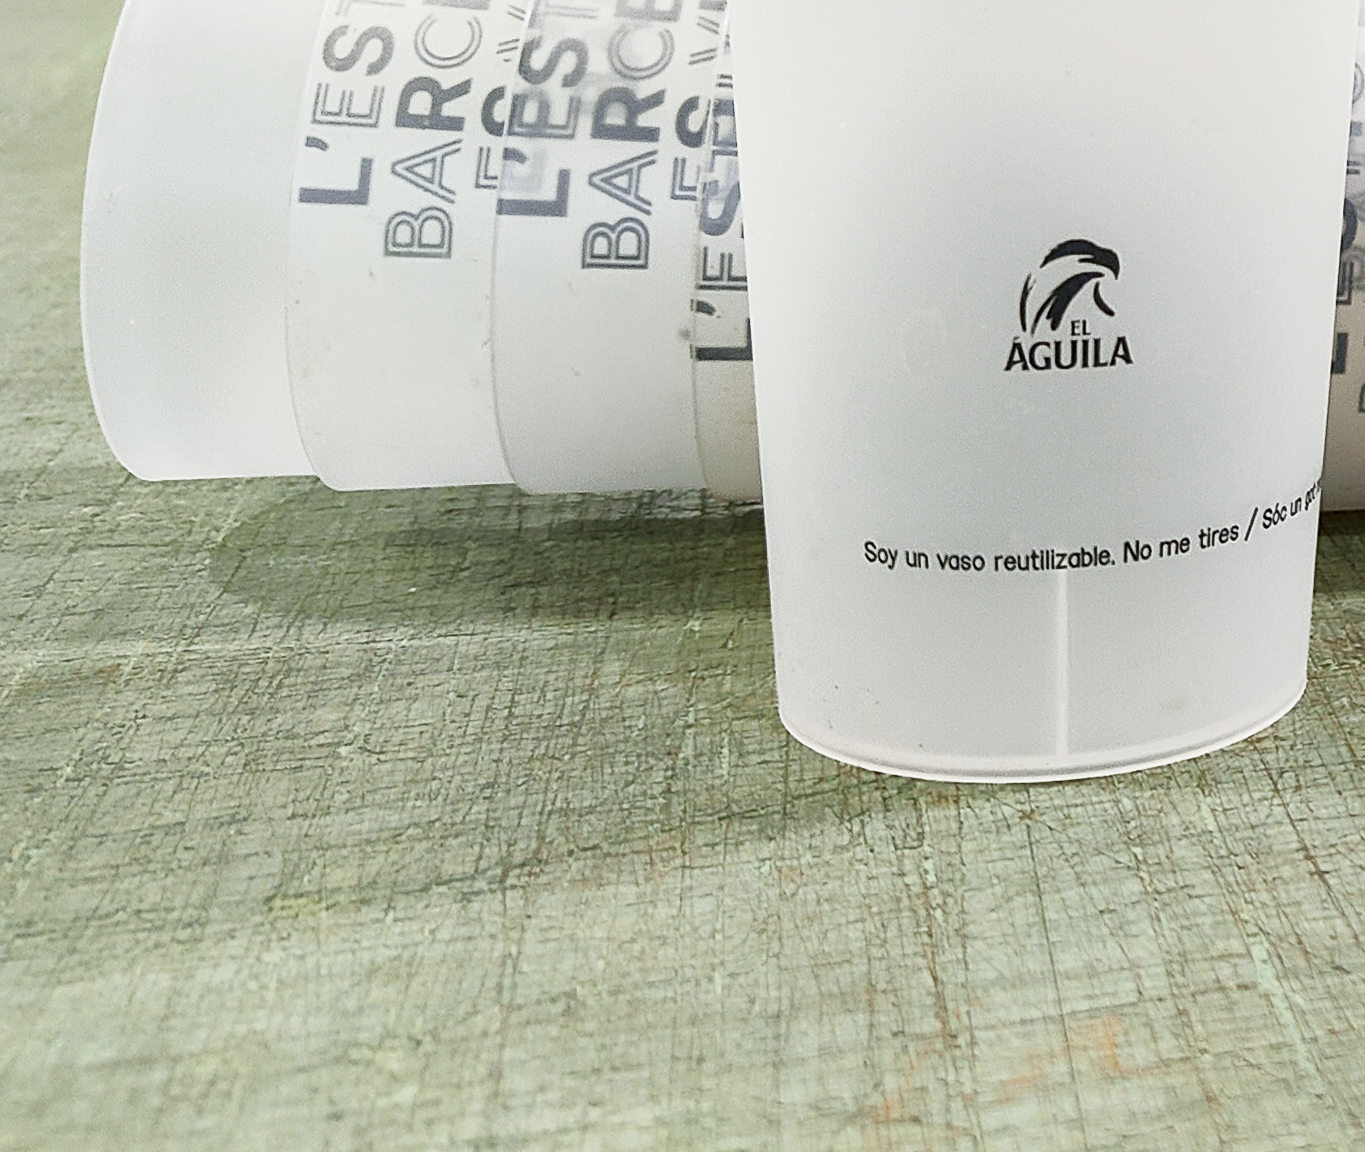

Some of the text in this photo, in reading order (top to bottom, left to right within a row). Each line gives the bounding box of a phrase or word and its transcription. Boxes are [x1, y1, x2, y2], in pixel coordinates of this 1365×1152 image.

[1070, 319, 1091, 336] EL
[1003, 336, 1133, 371] ÁGUILA
[864, 541, 898, 569] Soy
[906, 549, 928, 569] un
[937, 552, 985, 571] vaso
[994, 546, 1115, 571] reutilizable.
[1123, 540, 1152, 563] No
[1159, 535, 1190, 558] me
[1198, 524, 1239, 549] tires
[1262, 502, 1287, 529] Sóc
[1290, 496, 1302, 517] un
